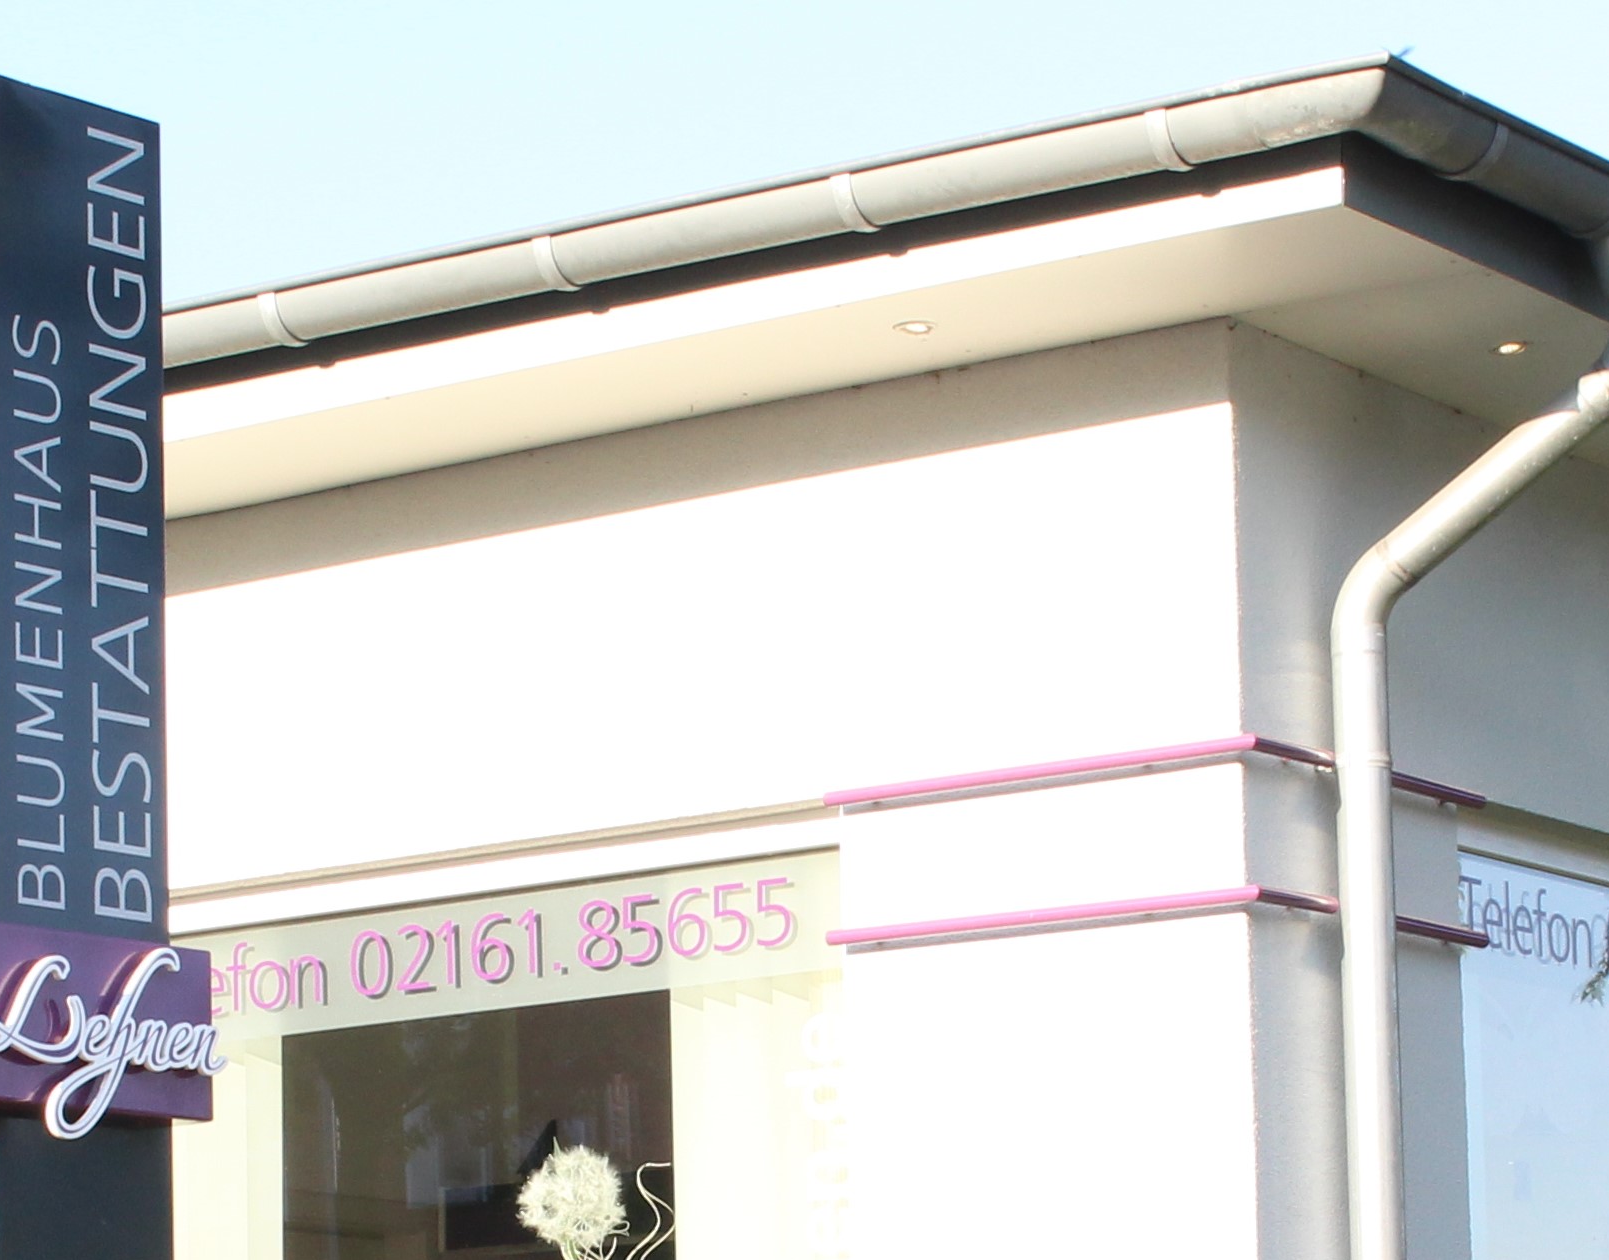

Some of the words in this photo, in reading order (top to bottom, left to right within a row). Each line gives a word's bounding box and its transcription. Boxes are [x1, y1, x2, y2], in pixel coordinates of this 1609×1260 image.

[11, 313, 67, 911] BLUMENHAUS
[86, 125, 153, 923] BESTATTUNGEN
[211, 941, 322, 1015] efon
[350, 876, 794, 997] 02161.85655
[1459, 875, 1592, 968] Telefon
